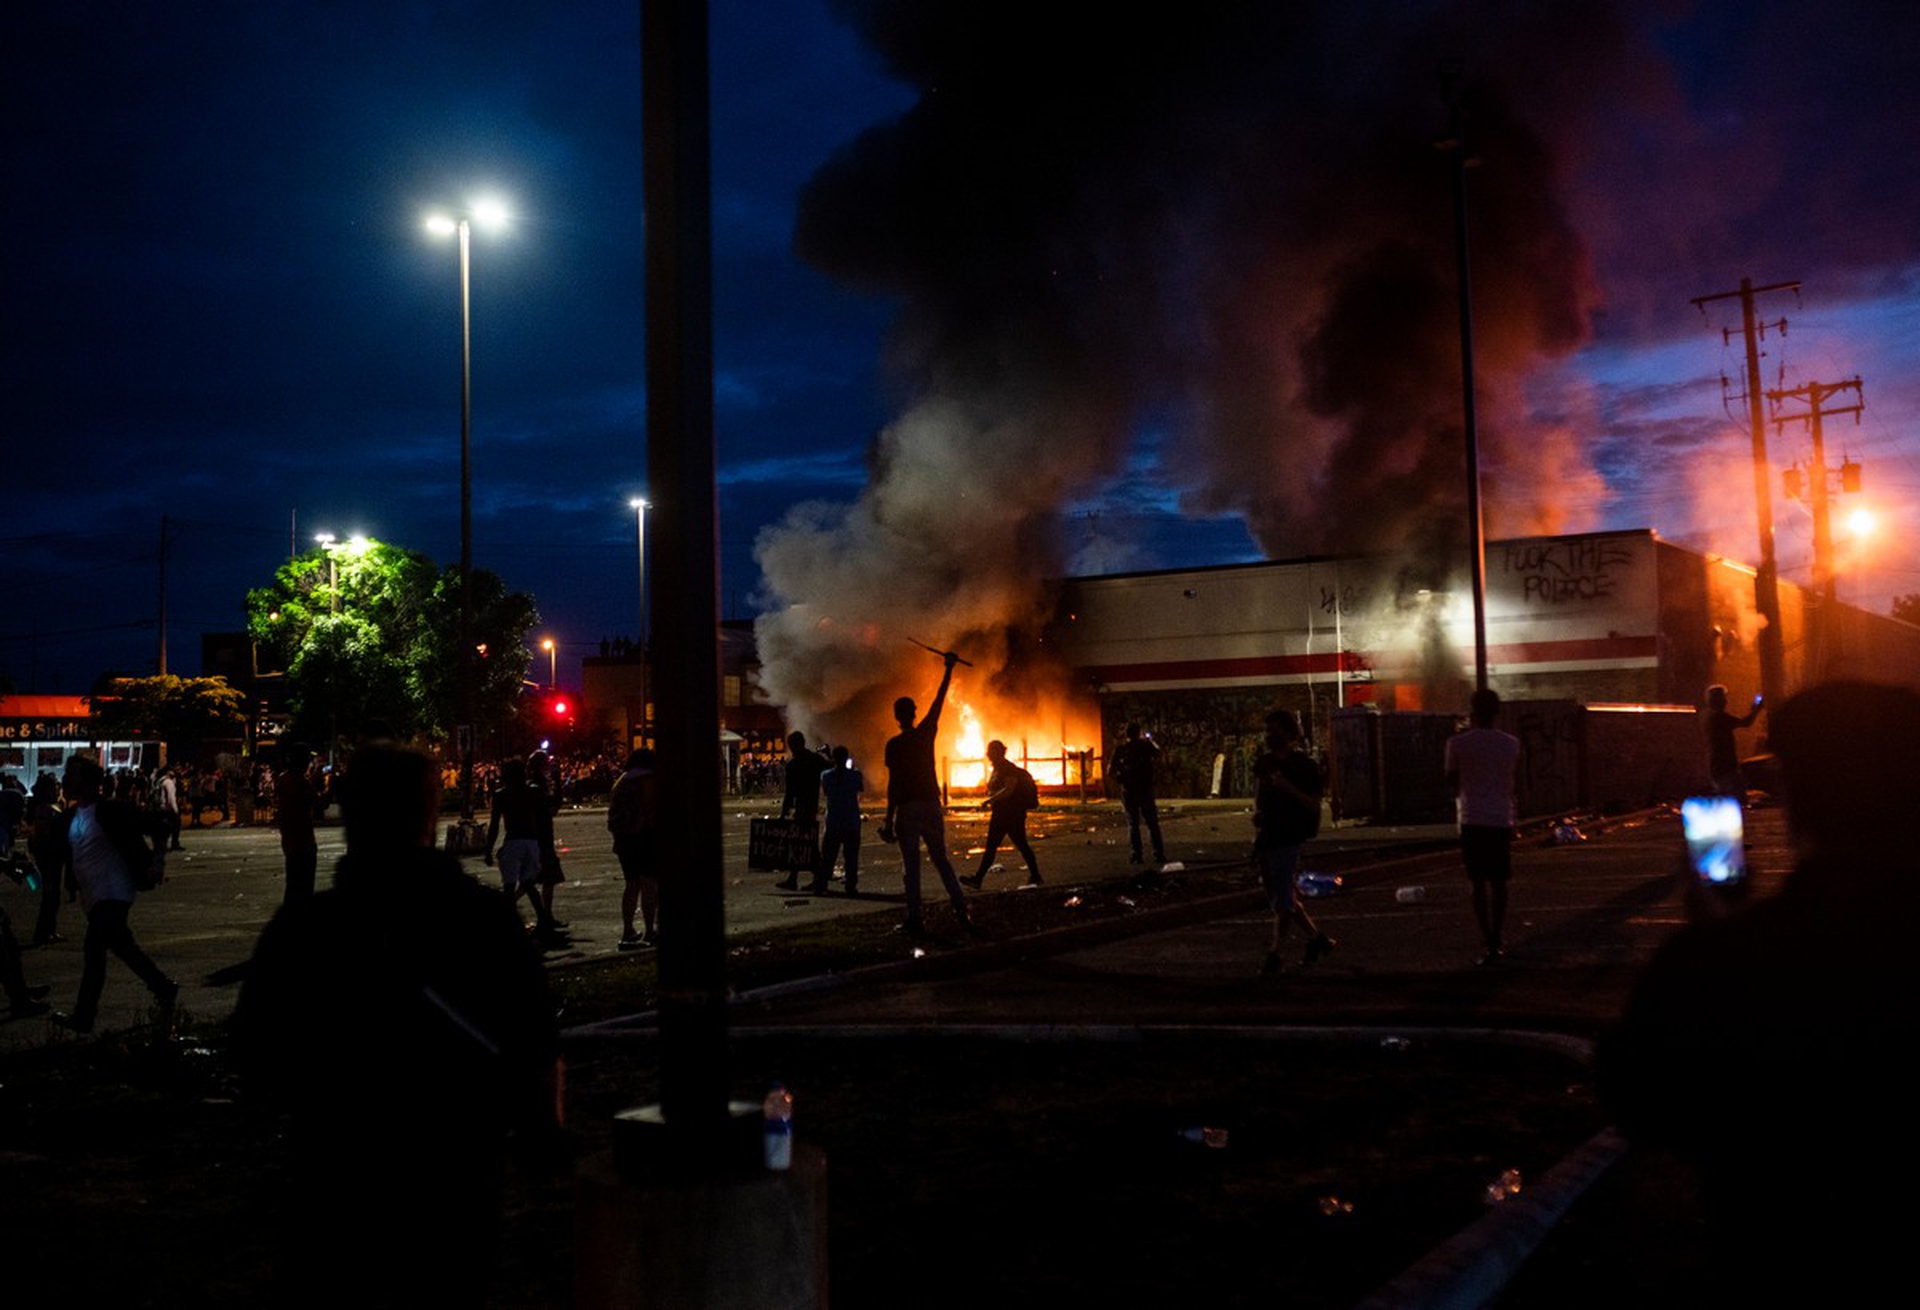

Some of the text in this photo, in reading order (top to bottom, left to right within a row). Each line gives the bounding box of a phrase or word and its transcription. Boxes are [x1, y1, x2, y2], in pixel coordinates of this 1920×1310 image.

[1560, 540, 1632, 572] THE
[18, 721, 31, 738] &
[34, 721, 88, 739] Spirits
